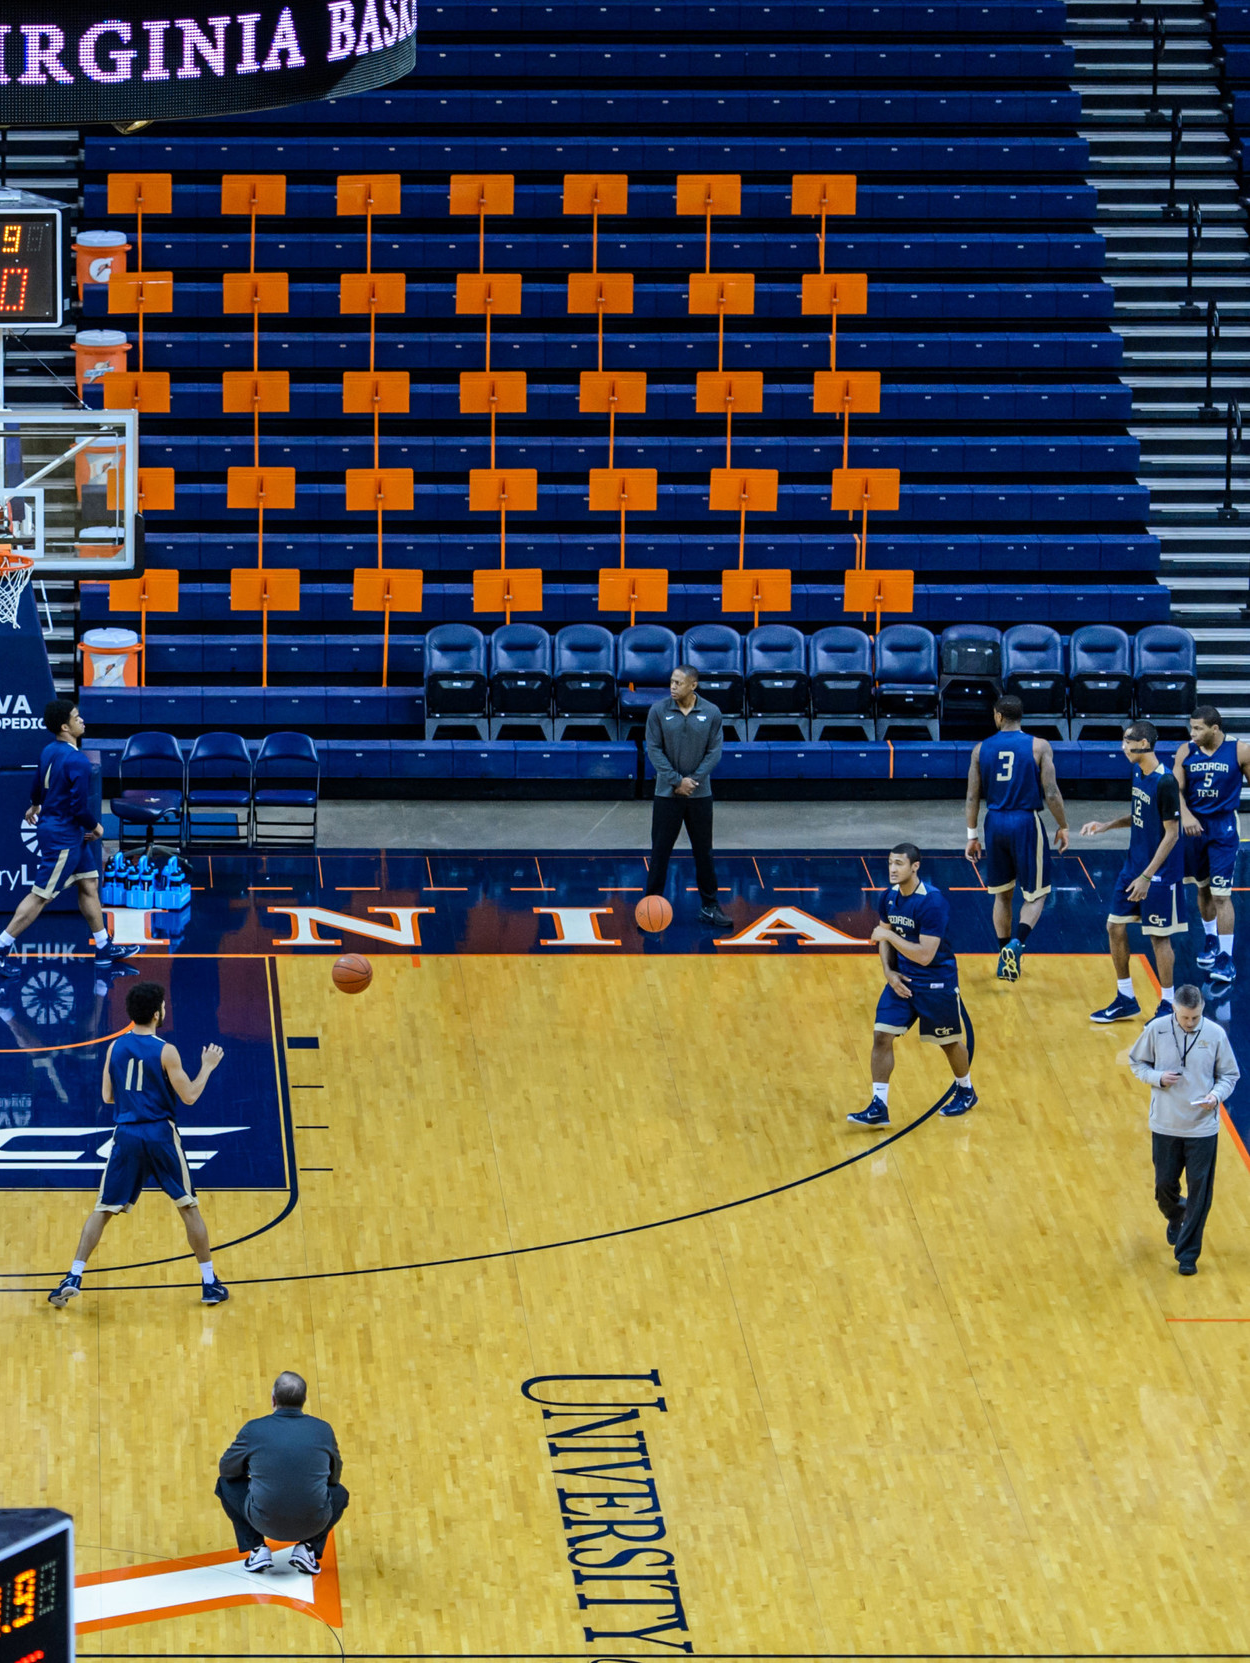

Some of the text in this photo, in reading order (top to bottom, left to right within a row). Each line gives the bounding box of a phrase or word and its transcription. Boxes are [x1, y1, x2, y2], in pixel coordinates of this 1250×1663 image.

[996, 751, 1015, 782] 3
[1190, 762, 1229, 773] GEORGIA
[1203, 772, 1215, 788] 5
[1197, 789, 1219, 798] TECH
[125, 1057, 144, 1092] 11
[520, 1368, 695, 1654] UNIVERSITY
